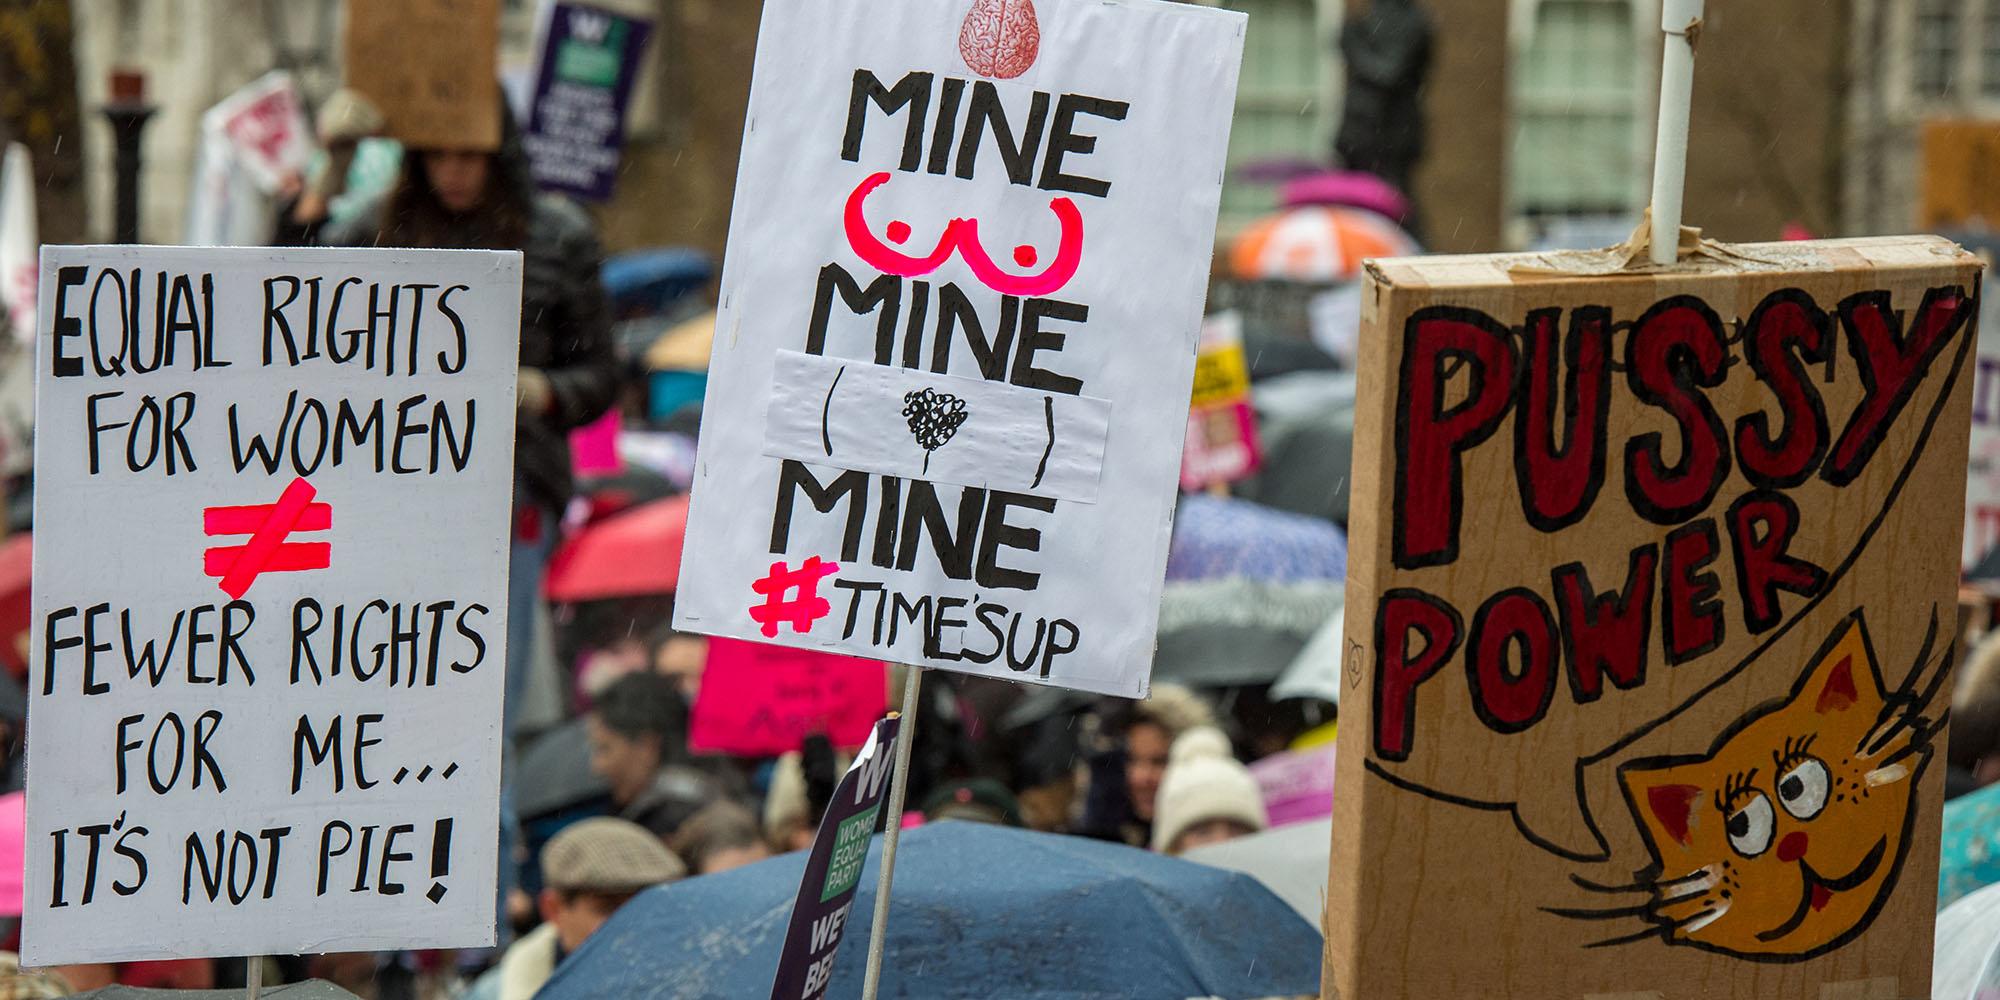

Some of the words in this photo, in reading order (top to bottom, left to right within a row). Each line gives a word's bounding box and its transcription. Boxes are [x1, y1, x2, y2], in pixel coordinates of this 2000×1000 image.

[841, 68, 1129, 198] MINE
[52, 265, 232, 377] EQUAL
[262, 275, 470, 377] RIGHTS
[805, 262, 1089, 396] MINE
[87, 391, 198, 476] FOR
[228, 389, 476, 477] WOMEN
[1393, 285, 1976, 570] PUSSY
[768, 458, 1057, 591] MINE
[43, 599, 255, 696] FEWER
[289, 597, 490, 687] RIGHTS
[1373, 490, 1829, 761] POWER
[116, 709, 227, 795] FOR
[291, 713, 459, 795] ME...
[49, 810, 151, 908] IT'S
[182, 825, 291, 905] NOT
[316, 816, 454, 904] PIE!
